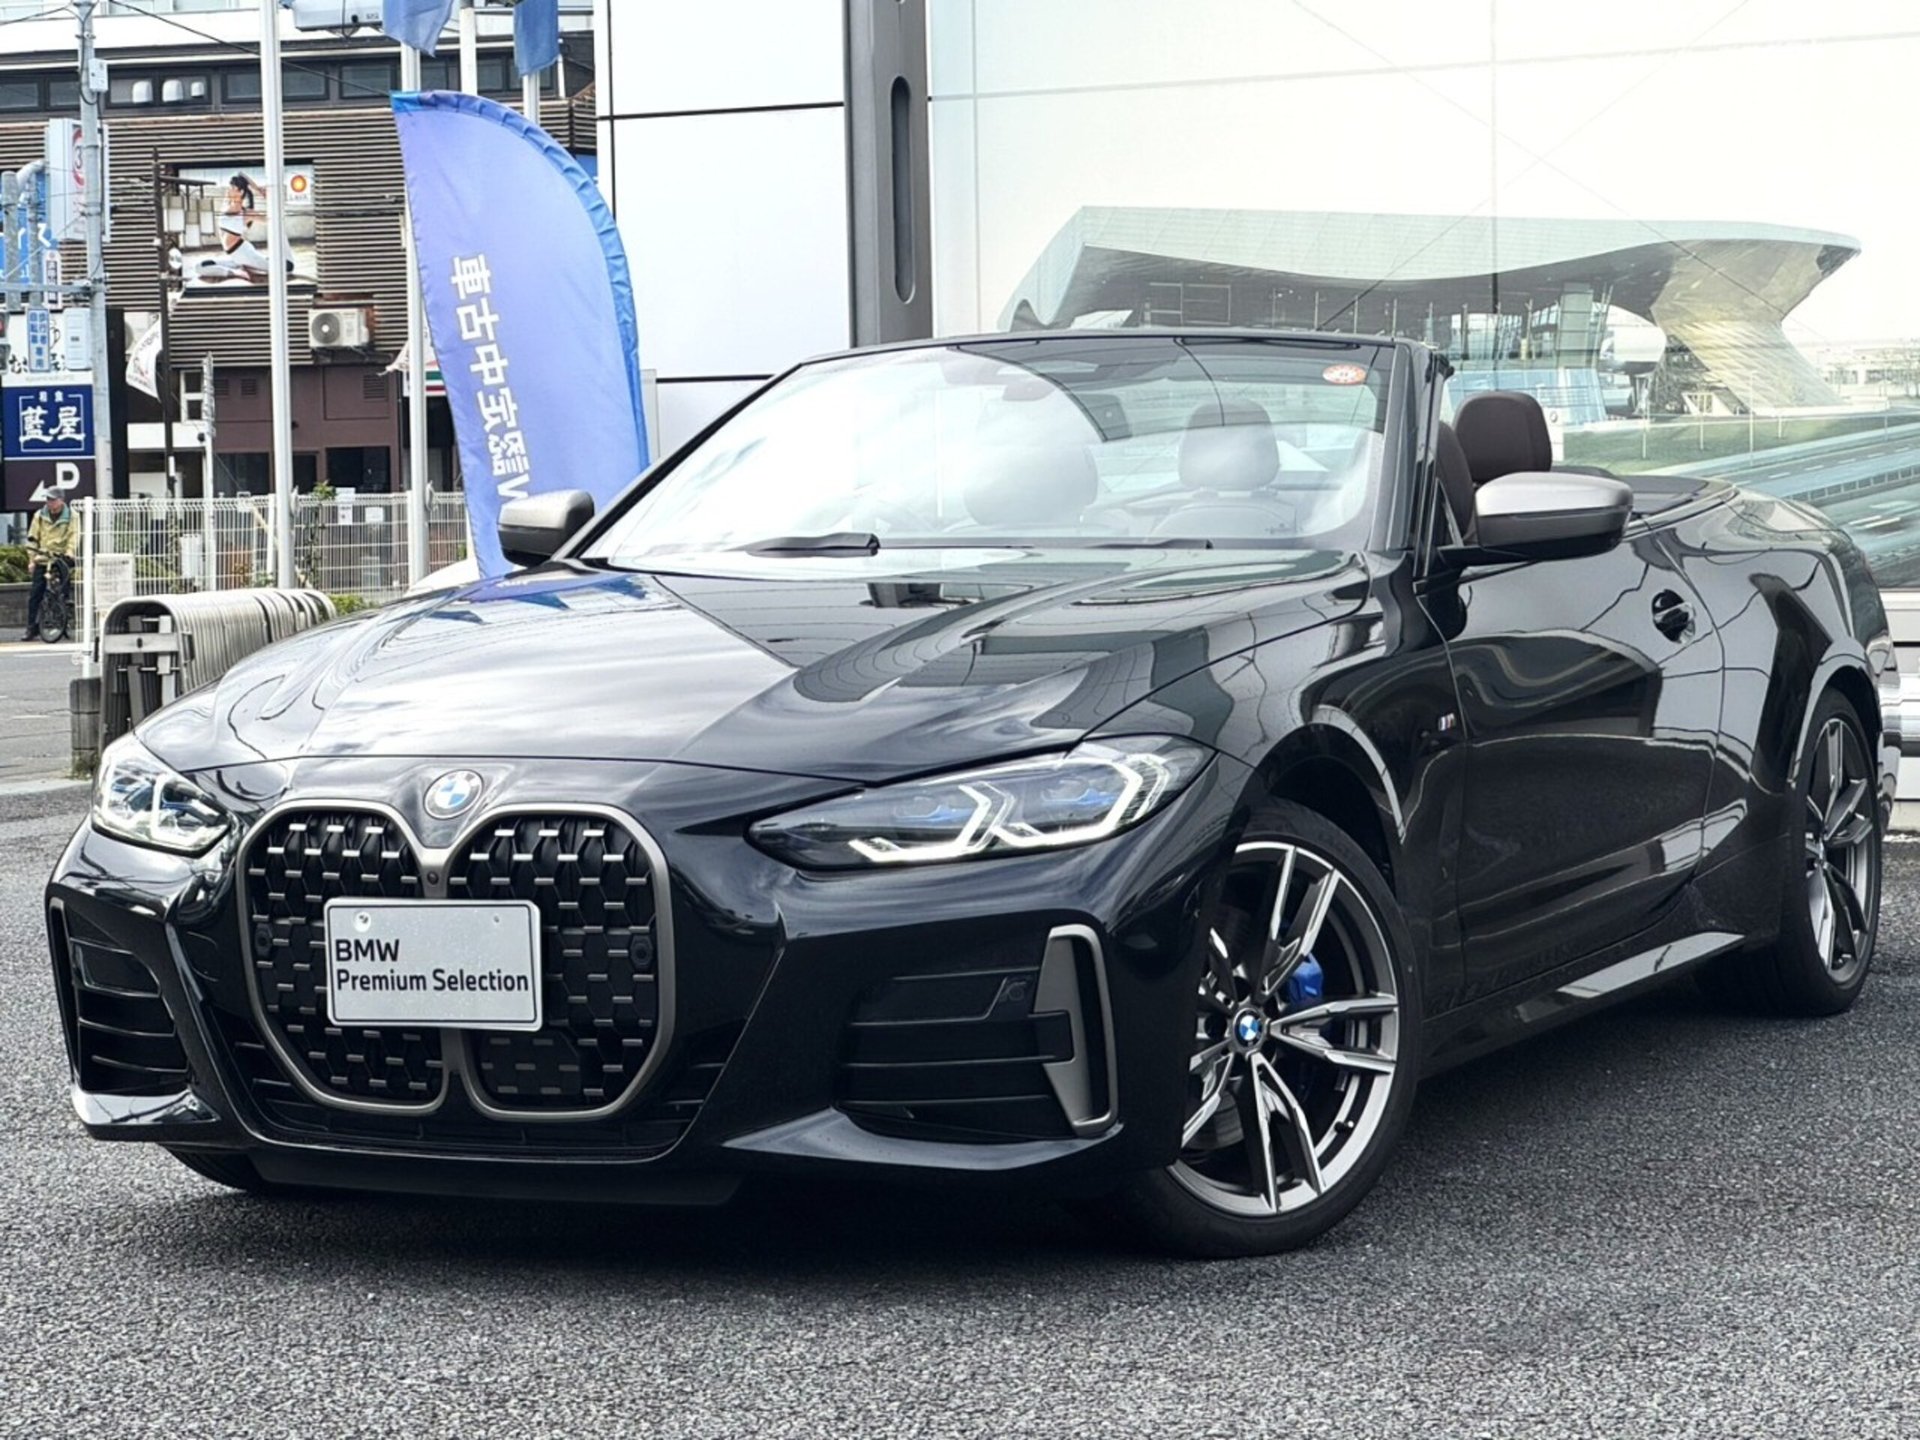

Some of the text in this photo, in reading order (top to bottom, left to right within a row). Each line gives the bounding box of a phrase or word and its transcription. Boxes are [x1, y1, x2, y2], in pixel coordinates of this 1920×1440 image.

[19, 405, 86, 443] 藍屋
[55, 461, 80, 490] P
[335, 938, 400, 962] BMW
[337, 968, 529, 992] Premium Selection
